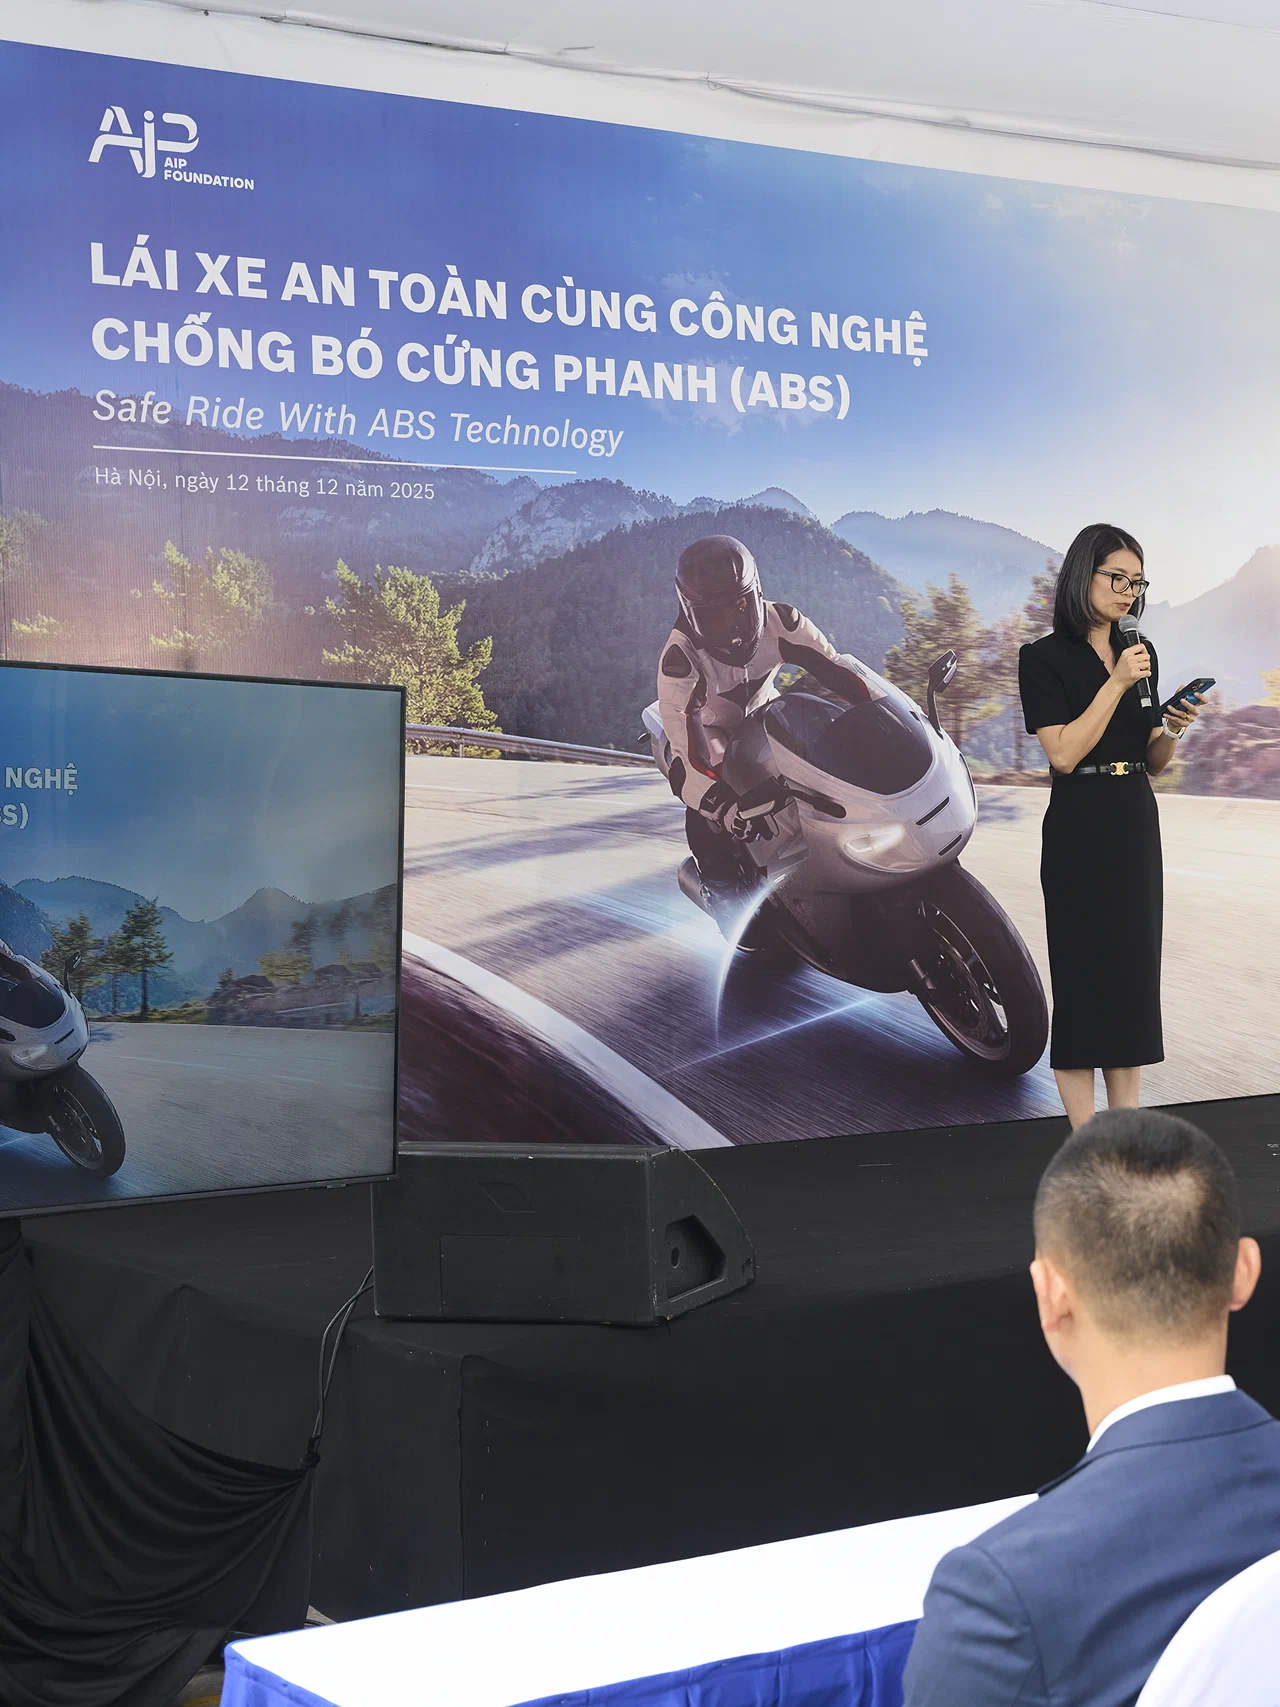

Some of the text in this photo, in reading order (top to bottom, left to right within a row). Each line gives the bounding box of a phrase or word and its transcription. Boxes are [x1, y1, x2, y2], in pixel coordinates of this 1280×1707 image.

[164, 157, 187, 168] AIP
[164, 170, 254, 189] FOUNDATION
[91, 234, 928, 366] LÁI XE AN TOÀN CÙNG CÔNG NGHỆ
[92, 312, 850, 419] CHỐNG BÓ CỨNG PHANH (ABS)
[93, 390, 623, 457] Safe Ride With ABS Technology
[96, 468, 434, 499] Hà Nội, ngày 12 tháng 12 năm 2025
[5, 762, 78, 796] NGHỆ
[0, 802, 29, 830] S)
